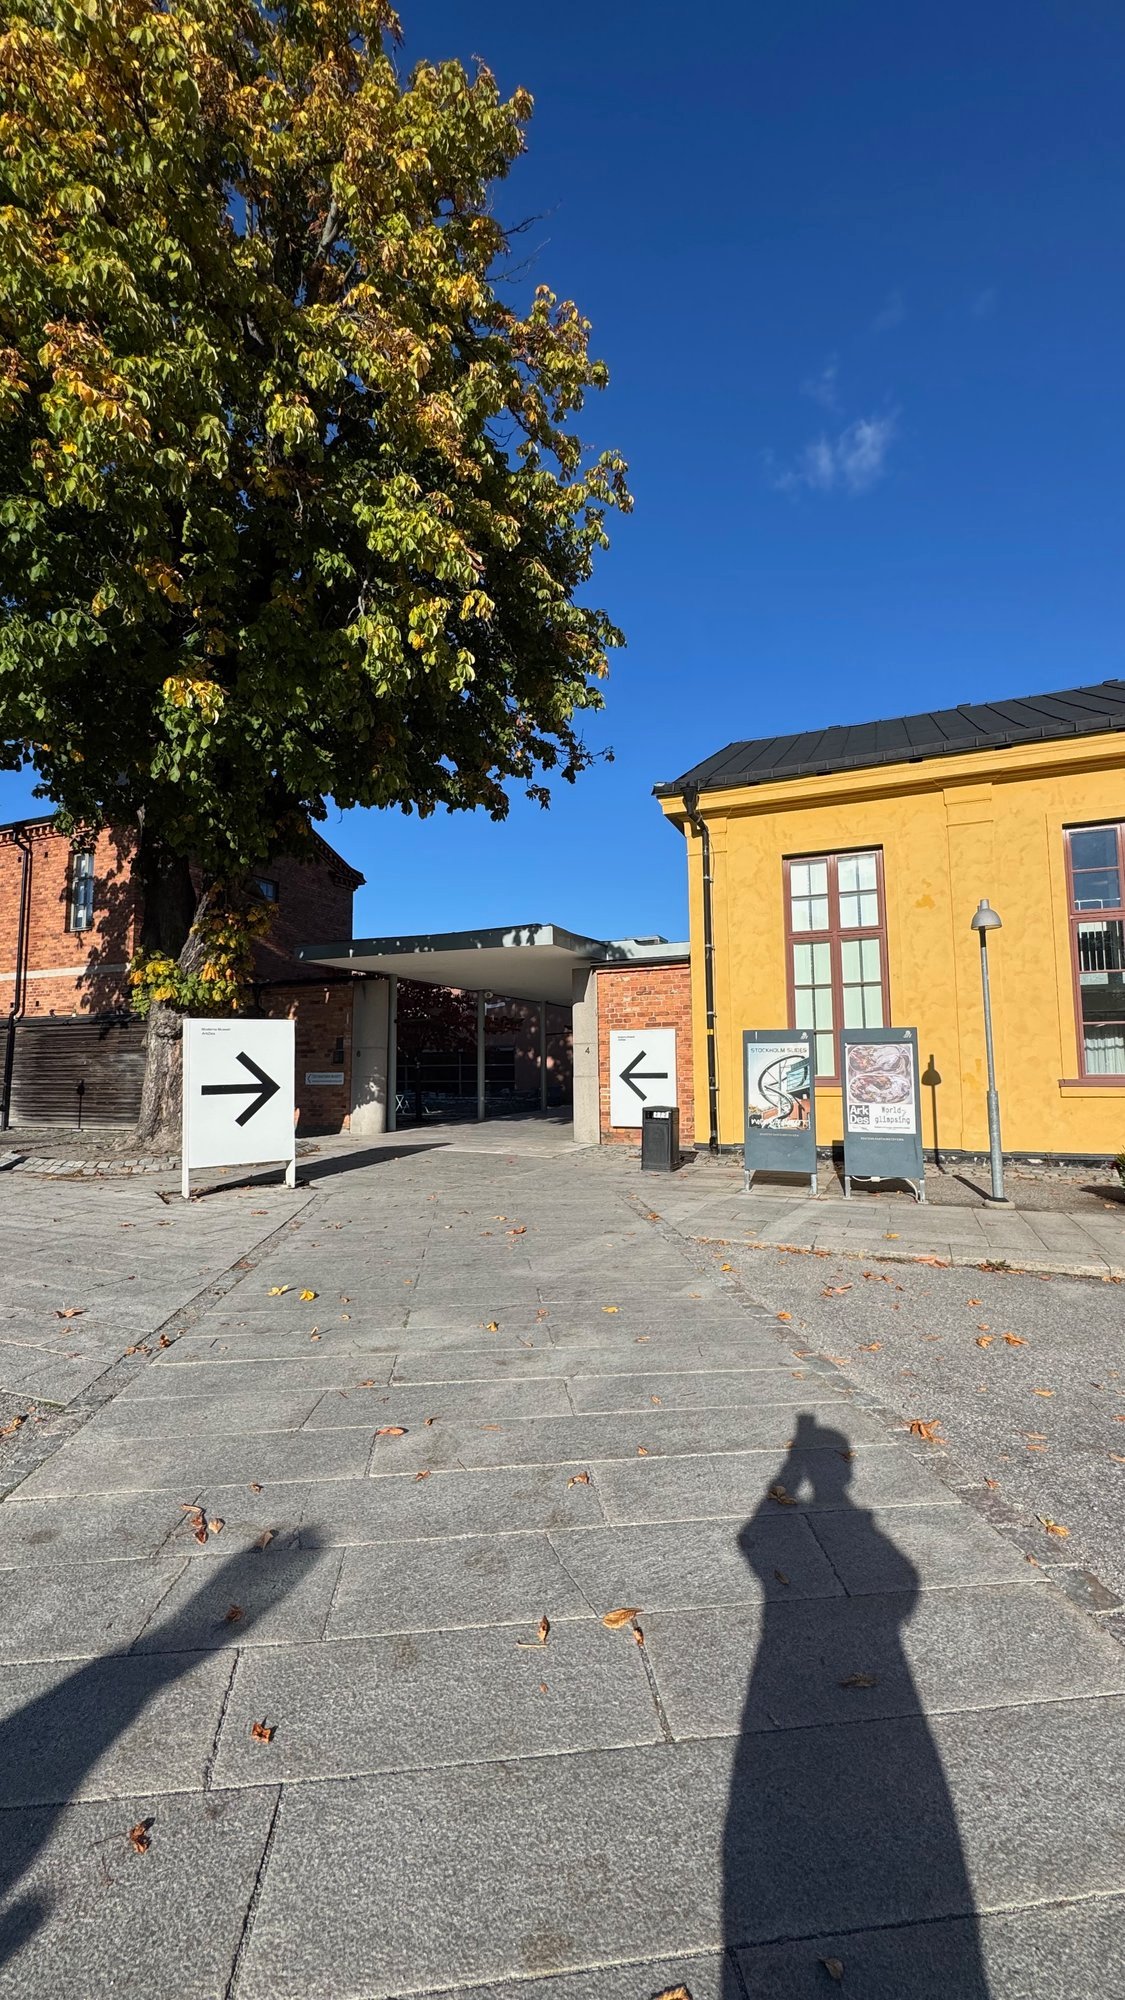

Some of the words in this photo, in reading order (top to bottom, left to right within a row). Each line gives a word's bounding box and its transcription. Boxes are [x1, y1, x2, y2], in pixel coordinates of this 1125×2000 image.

[585, 1046, 590, 1054] 4
[850, 1105, 869, 1115] Ark
[850, 1115, 869, 1124] Des
